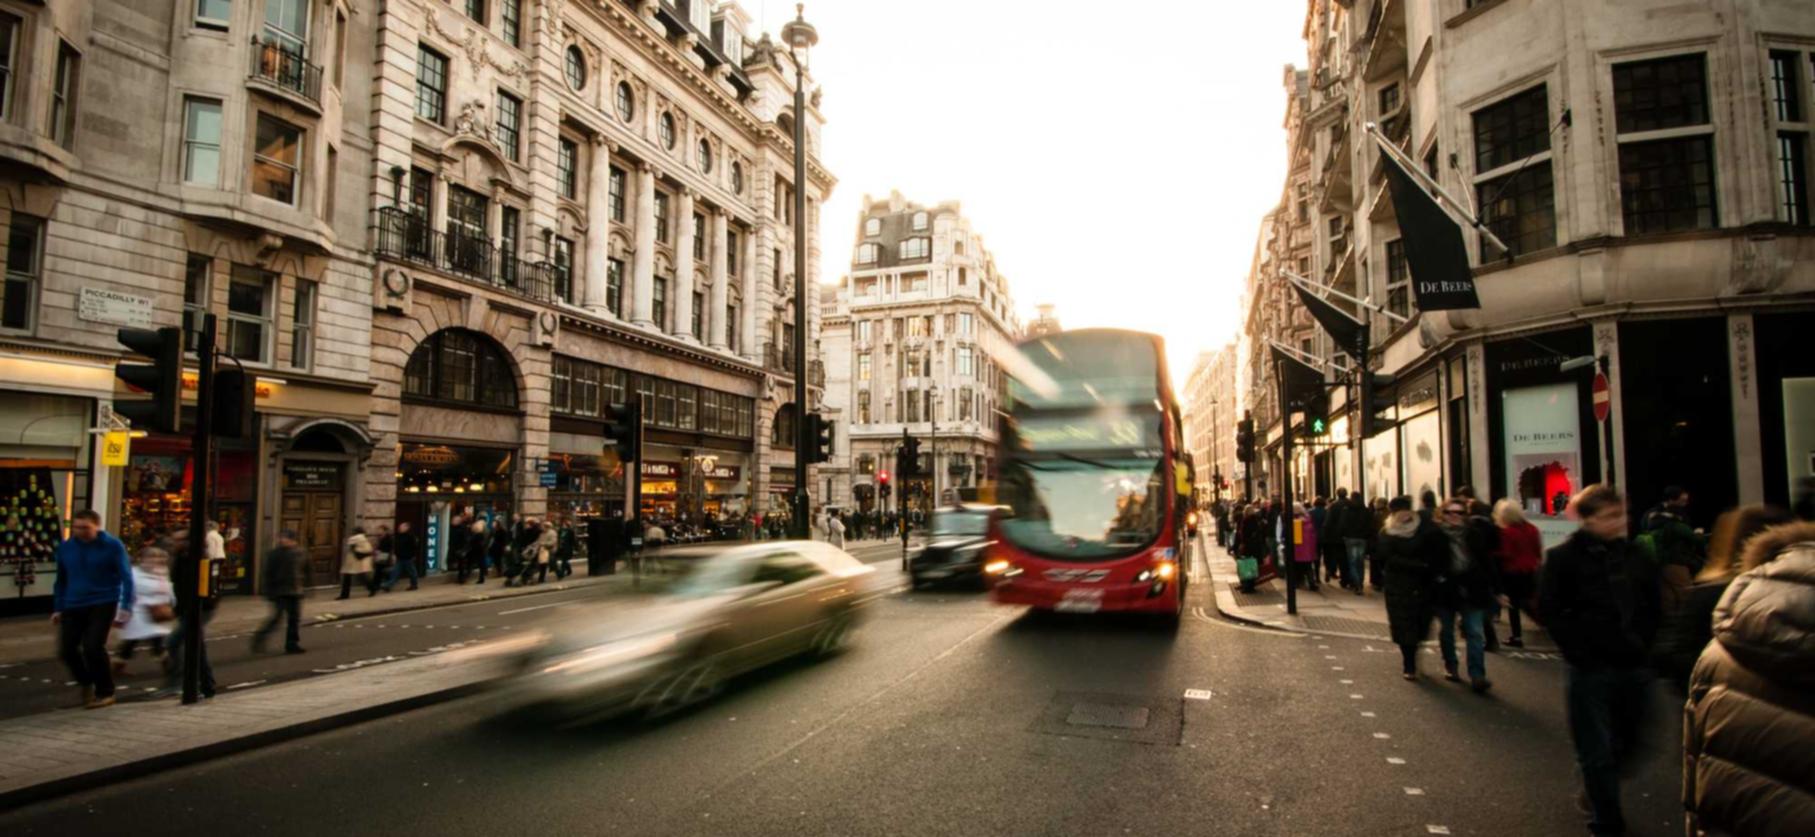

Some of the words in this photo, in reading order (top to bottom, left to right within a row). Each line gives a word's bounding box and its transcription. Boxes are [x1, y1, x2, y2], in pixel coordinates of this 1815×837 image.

[1420, 280, 1439, 294] DE
[85, 288, 135, 303] PICCADILLY
[1533, 432, 1574, 441] BEERS
[427, 514, 437, 569] MONEY
